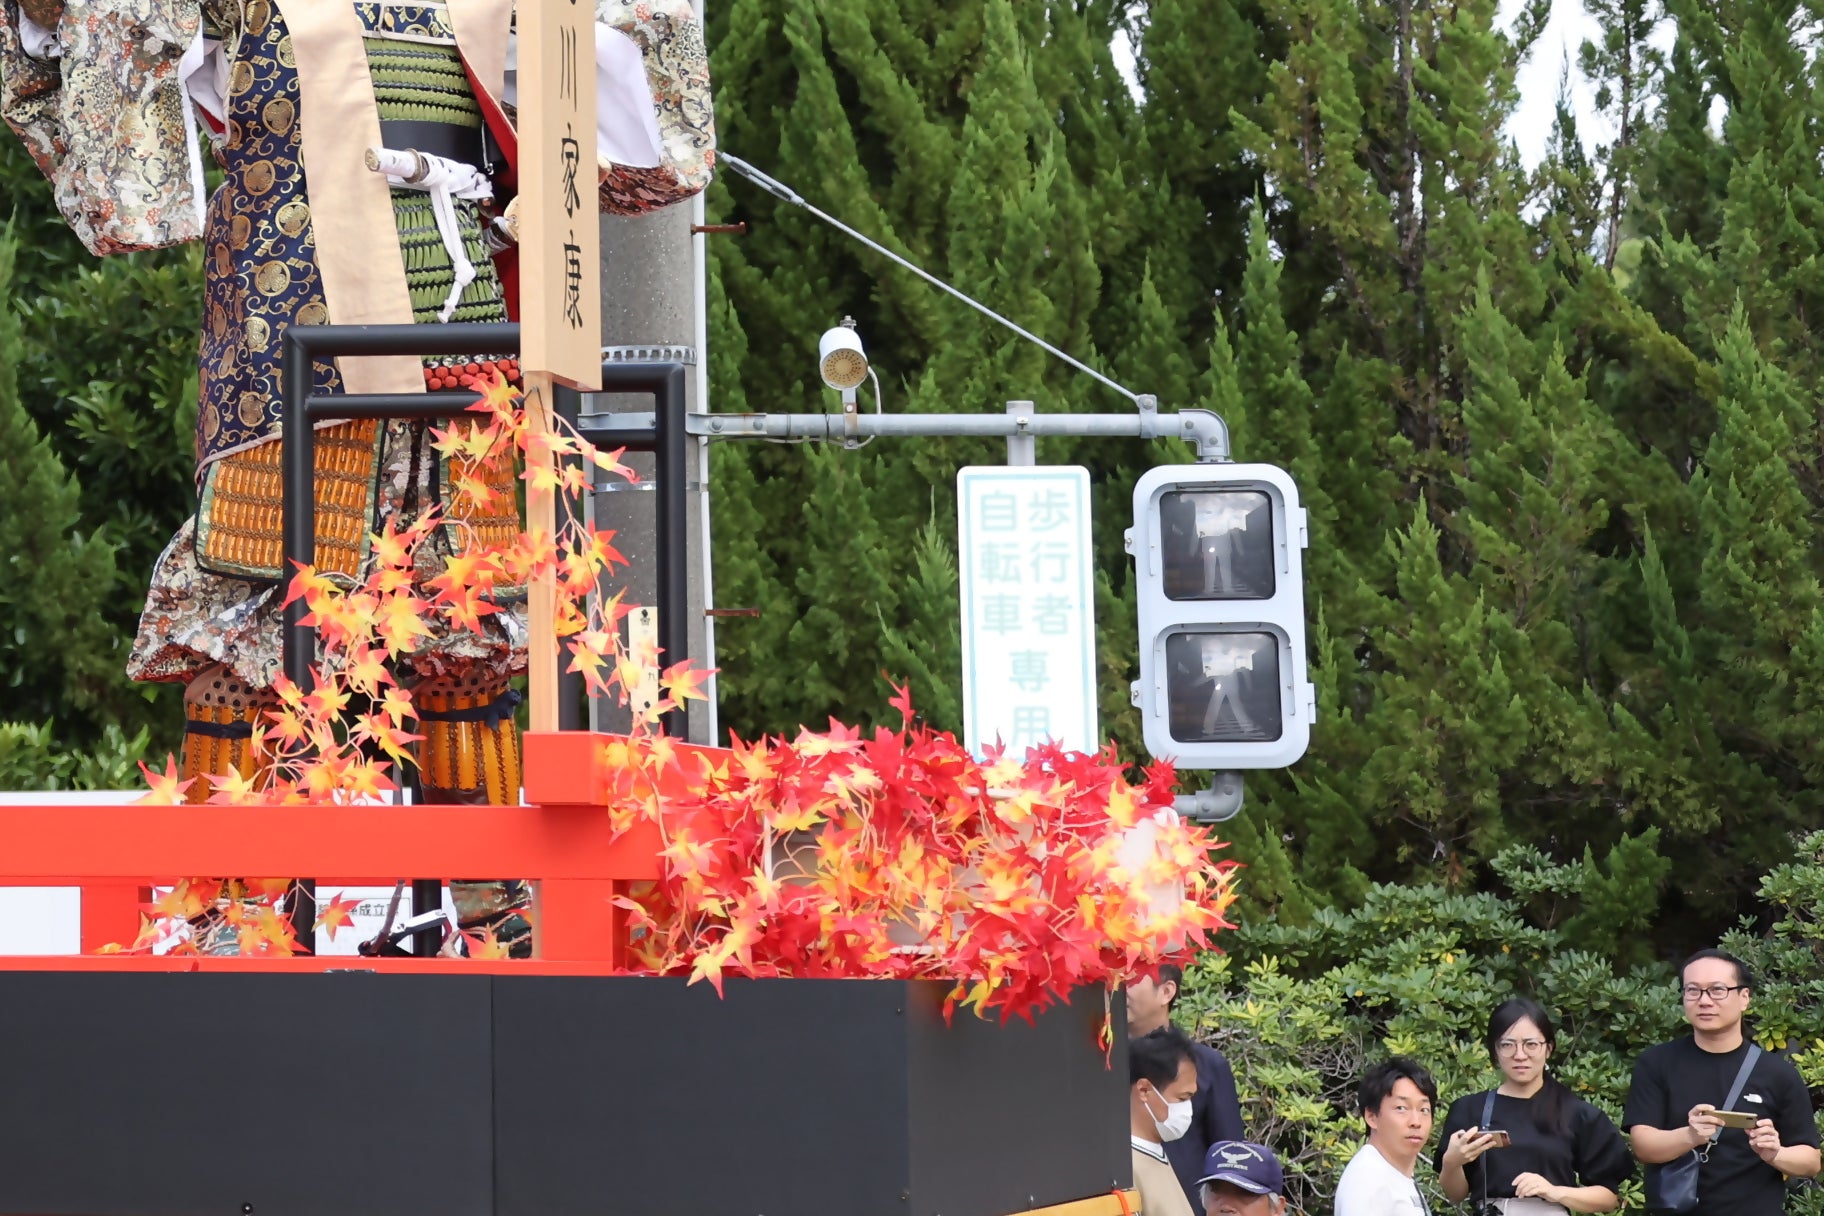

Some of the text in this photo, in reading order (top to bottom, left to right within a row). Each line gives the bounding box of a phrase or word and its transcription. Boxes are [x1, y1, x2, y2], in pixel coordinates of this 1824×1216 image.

[979, 490, 1023, 637] 自転車
[1028, 489, 1073, 636] 歩行者
[1009, 649, 1051, 747] 専用
